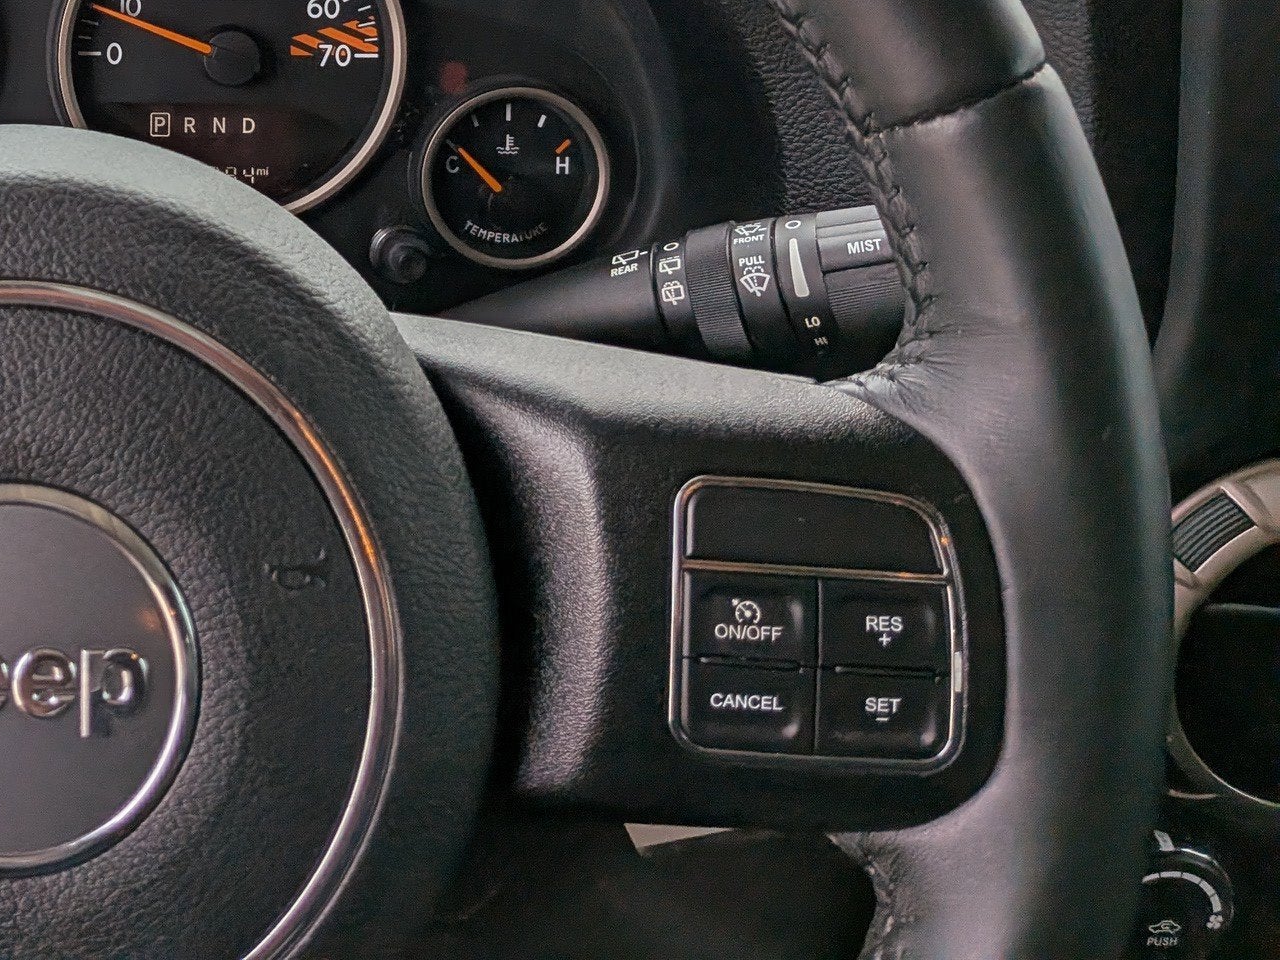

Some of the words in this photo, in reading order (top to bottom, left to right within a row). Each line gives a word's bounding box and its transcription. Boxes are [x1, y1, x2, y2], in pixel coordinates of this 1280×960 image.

[106, 42, 123, 65] 0
[318, 44, 353, 67] 70
[154, 116, 166, 133] P
[184, 117, 196, 133] R
[212, 117, 226, 134] N
[242, 117, 256, 134] D
[446, 155, 460, 174] C
[555, 156, 570, 175] H
[733, 231, 765, 245] FRONT
[846, 238, 882, 255] MIST
[610, 260, 638, 277] REAR
[738, 255, 765, 269] PULL
[804, 316, 821, 328] LO
[865, 615, 903, 632] RES
[714, 623, 782, 642] ON/OFF
[710, 692, 783, 711] CANCEL
[864, 697, 901, 713] SET
[1146, 936, 1179, 947] PUSH
